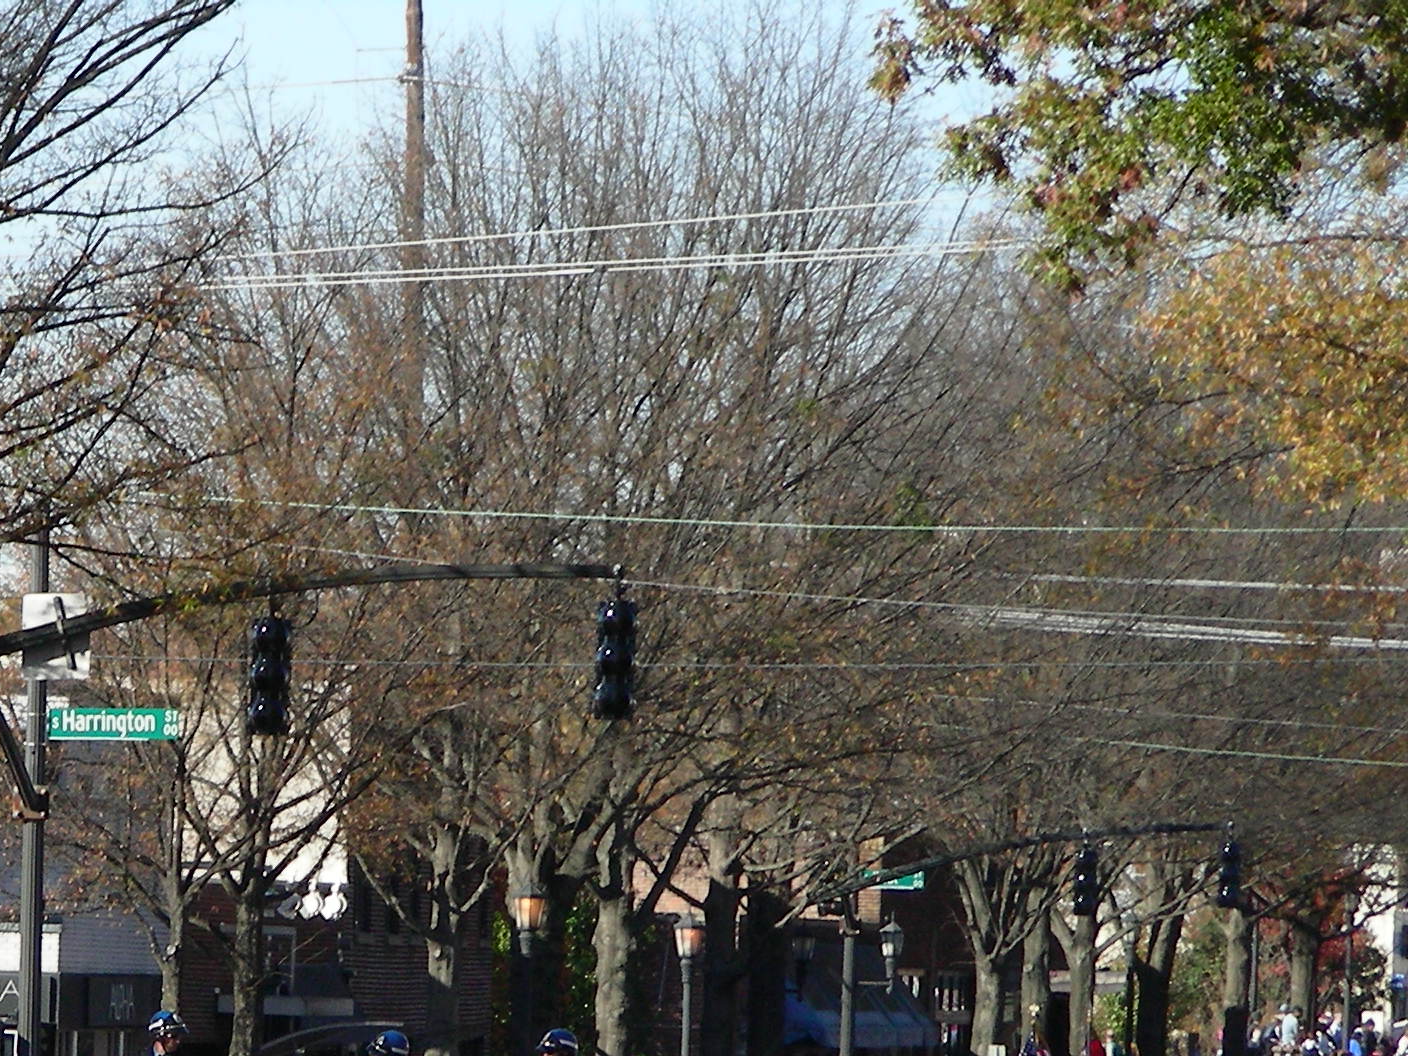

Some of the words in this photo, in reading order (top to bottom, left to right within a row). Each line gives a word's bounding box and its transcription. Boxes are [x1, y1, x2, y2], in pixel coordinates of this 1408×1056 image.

[51, 717, 60, 729] S
[62, 709, 156, 738] Harrington
[164, 710, 178, 722] ST
